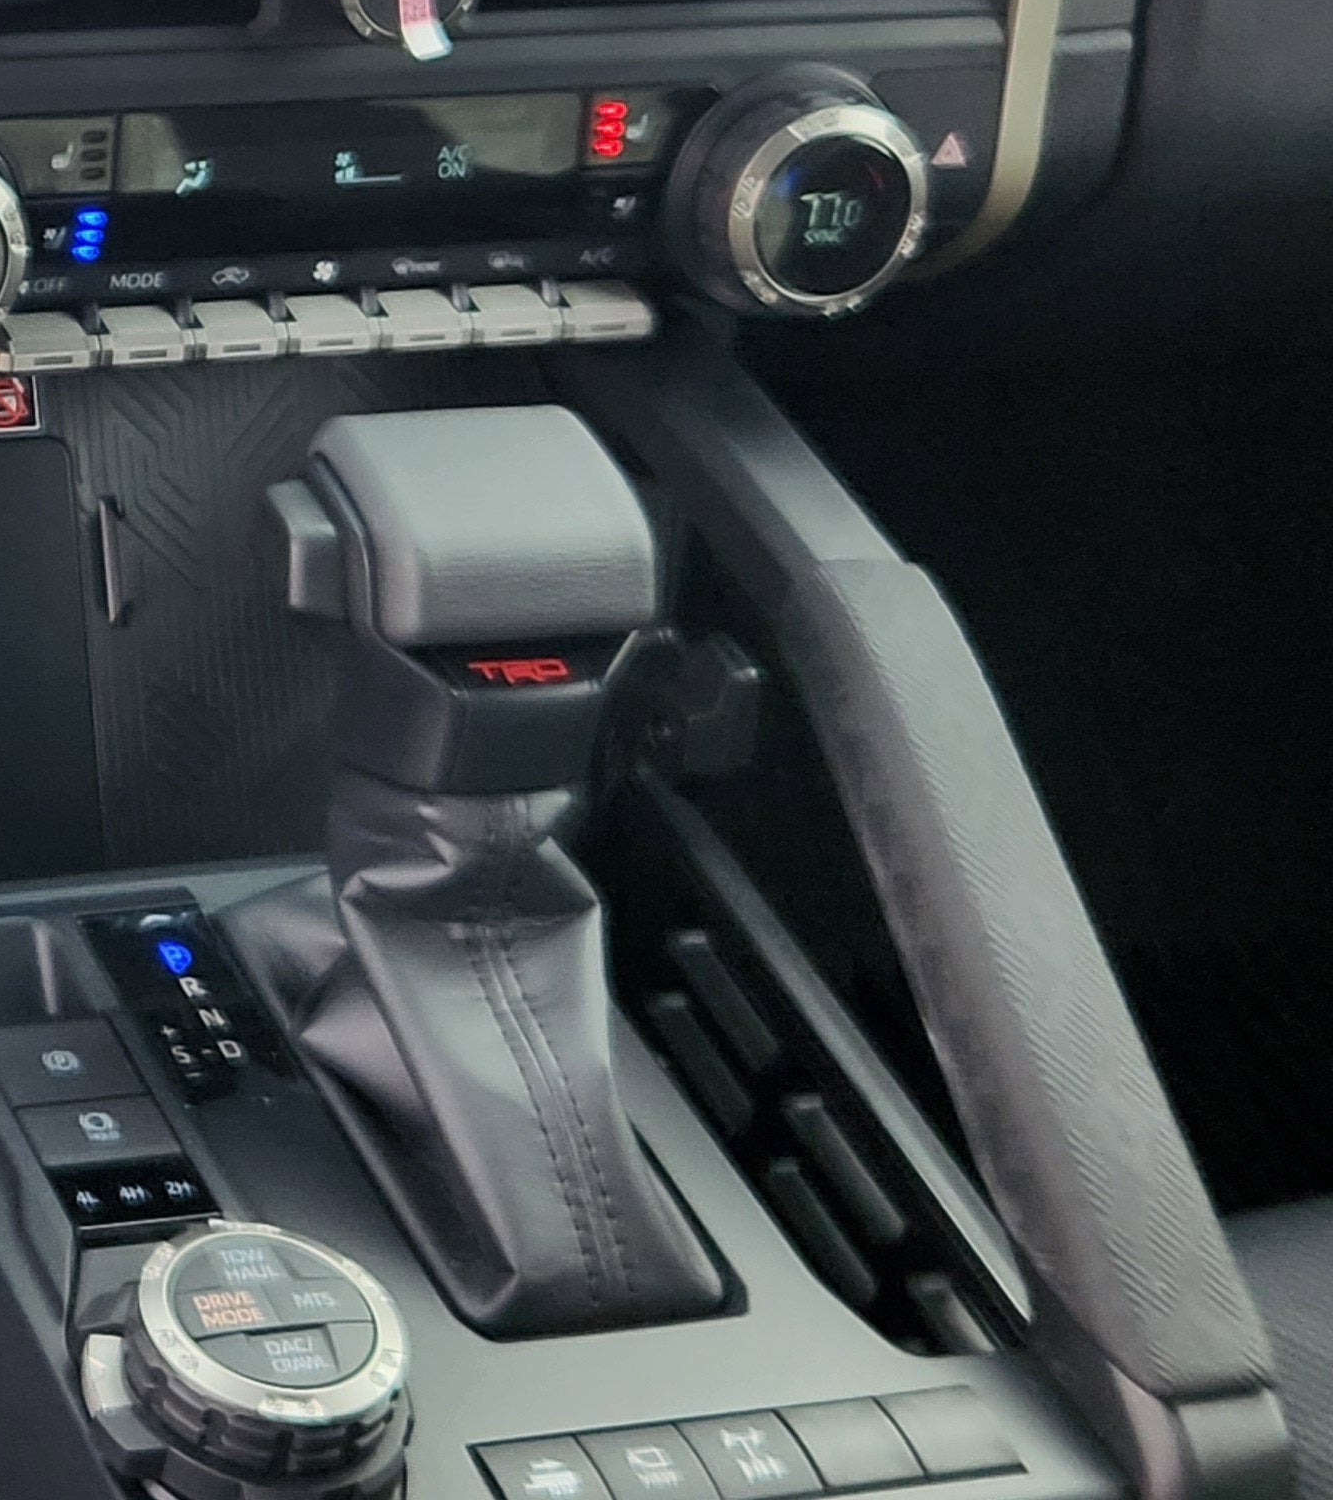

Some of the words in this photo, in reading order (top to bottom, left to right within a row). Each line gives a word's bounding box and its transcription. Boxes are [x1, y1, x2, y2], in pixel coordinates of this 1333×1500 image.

[438, 143, 470, 162] A/C
[438, 161, 468, 179] ON
[109, 271, 165, 289] MODE
[467, 657, 572, 685] TRD
[179, 976, 208, 998] R
[198, 1008, 227, 1027] N
[172, 1045, 191, 1064] S
[217, 1039, 242, 1058] D
[192, 1290, 255, 1311] DRIVE
[292, 1291, 335, 1309] MTS
[200, 1308, 265, 1329] MODE
